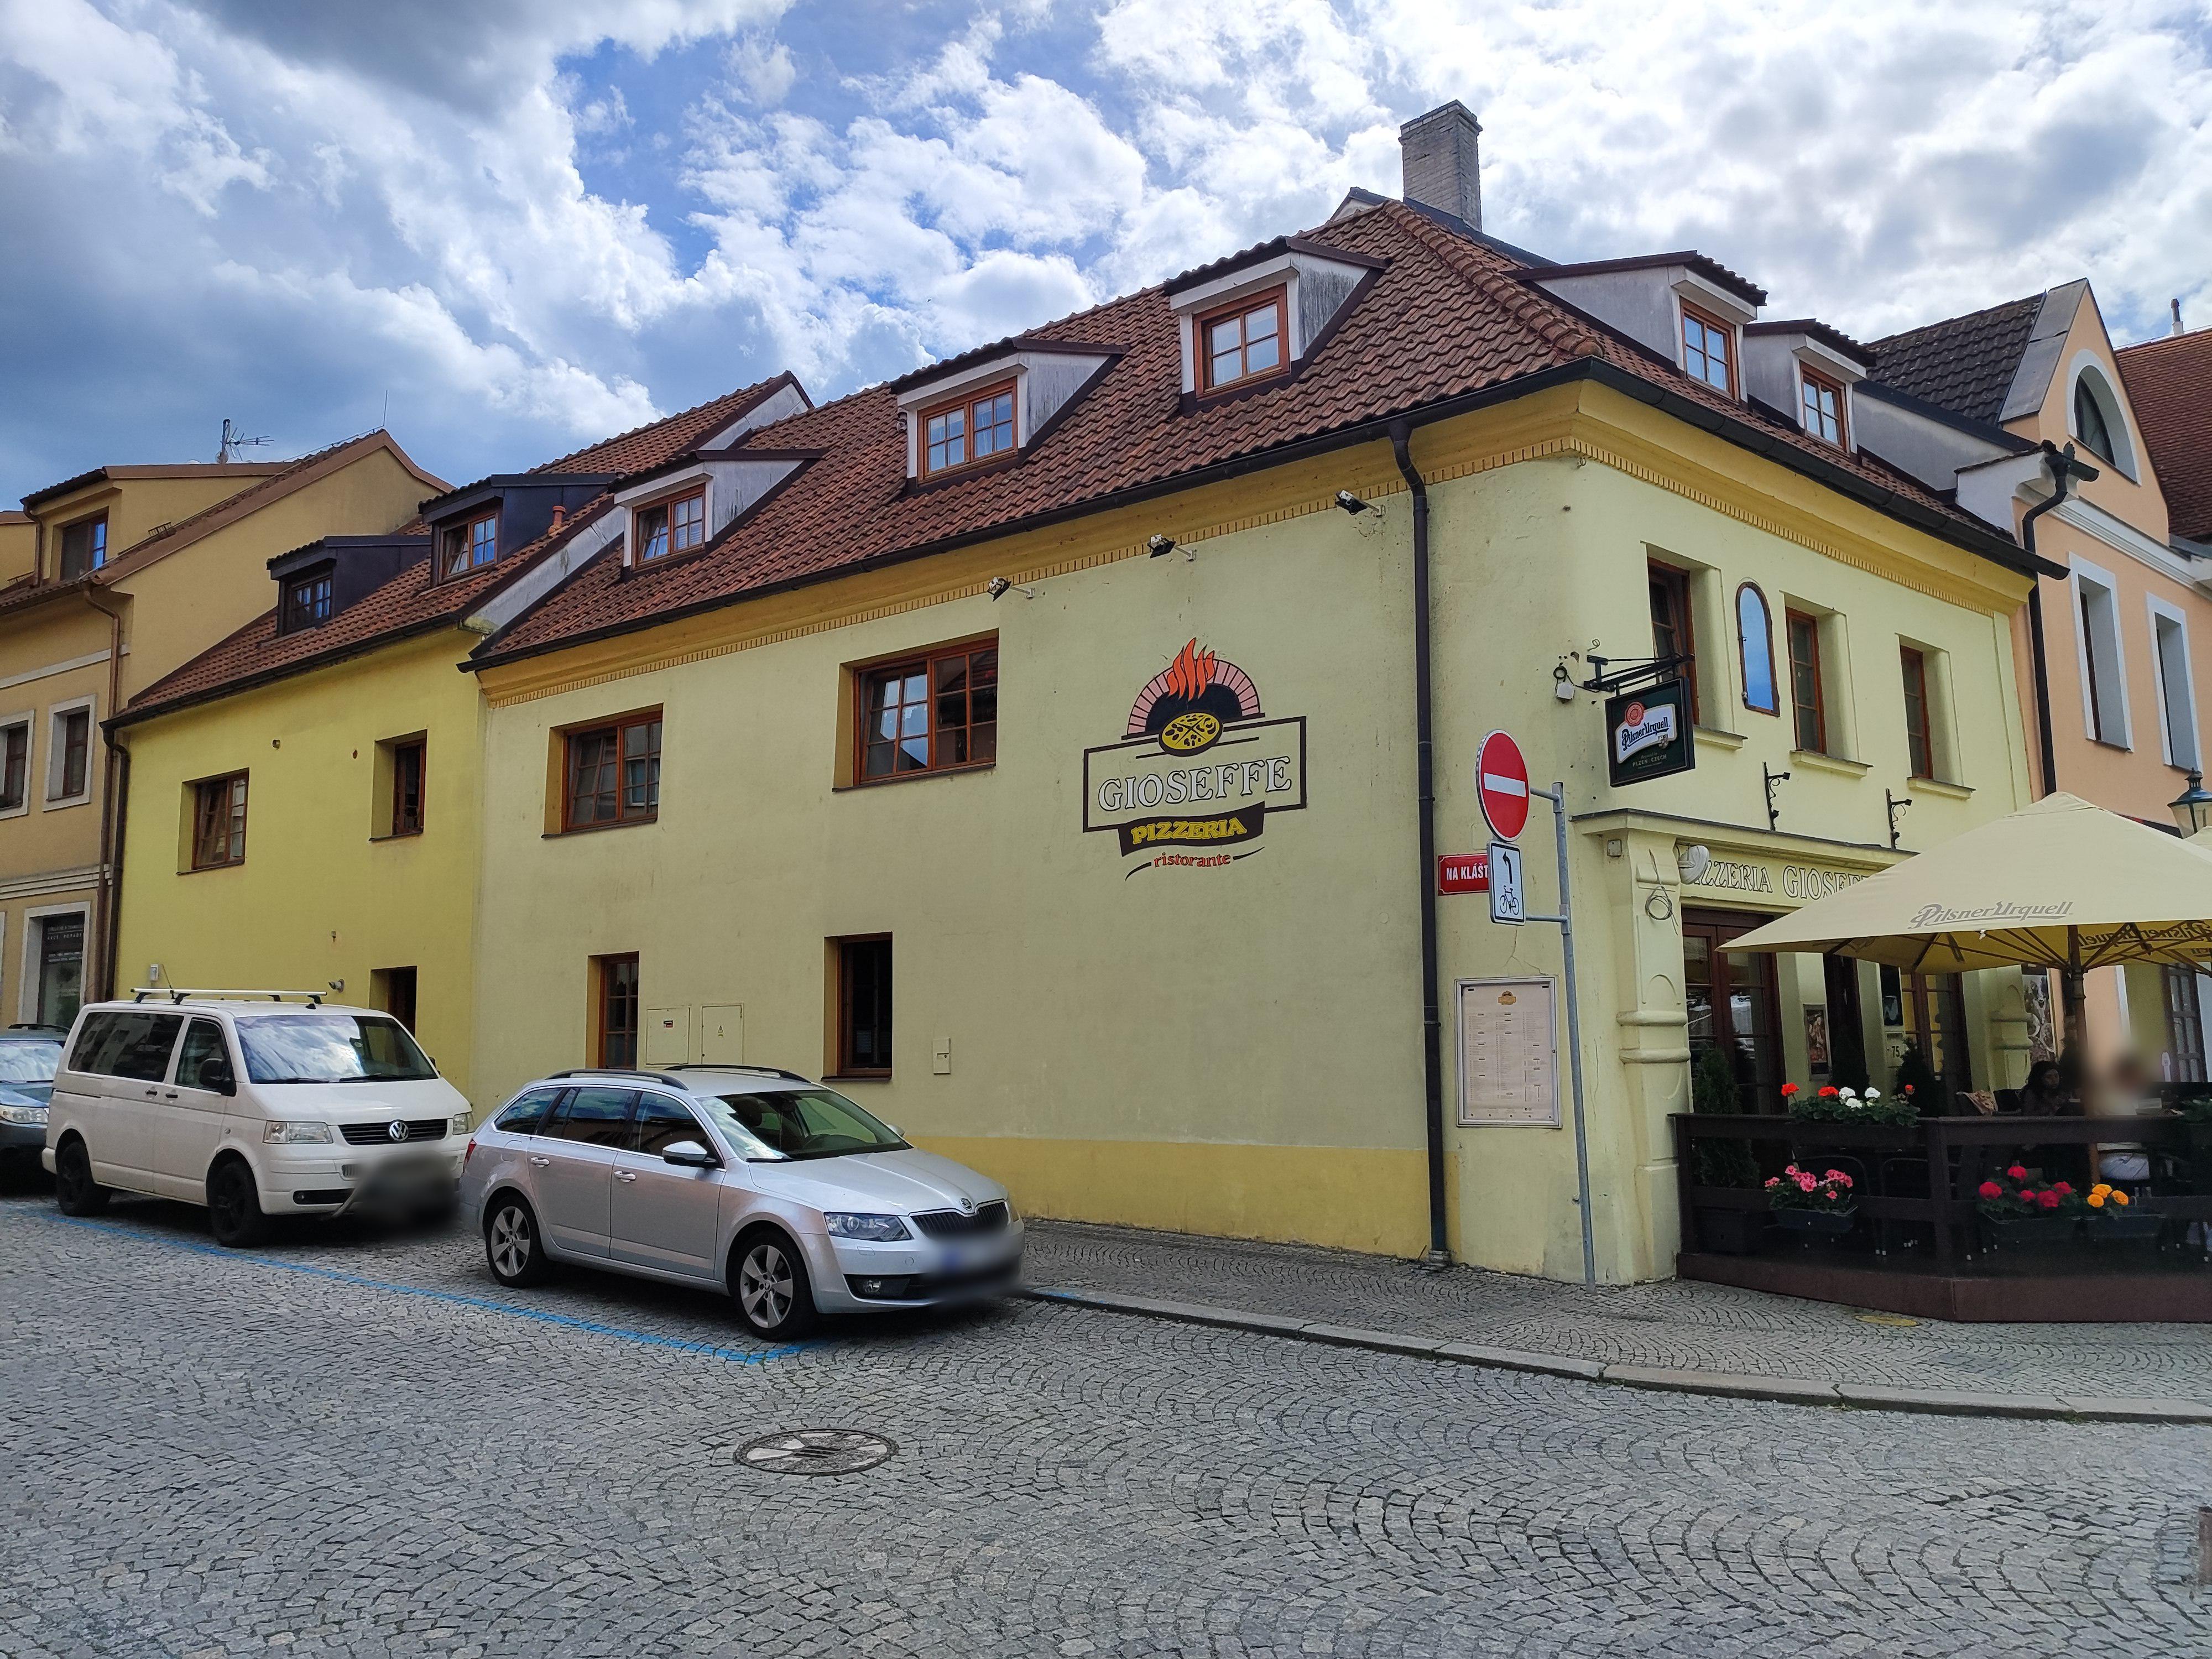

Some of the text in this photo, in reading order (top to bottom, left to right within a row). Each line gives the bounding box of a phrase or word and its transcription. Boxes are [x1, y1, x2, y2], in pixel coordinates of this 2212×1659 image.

[1621, 717, 1668, 751] Pilsner Urquell
[1098, 756, 1292, 811] GIOSEFFE
[1131, 817, 1247, 844] PIZZERIA
[1154, 852, 1231, 867] ristorante
[1446, 862, 1488, 881] NA KLÁŠT
[1694, 860, 1870, 900] ZZERIA GIOSE
[1907, 901, 2073, 930] Pilsner Urquell
[1891, 1046, 1900, 1057] 75
